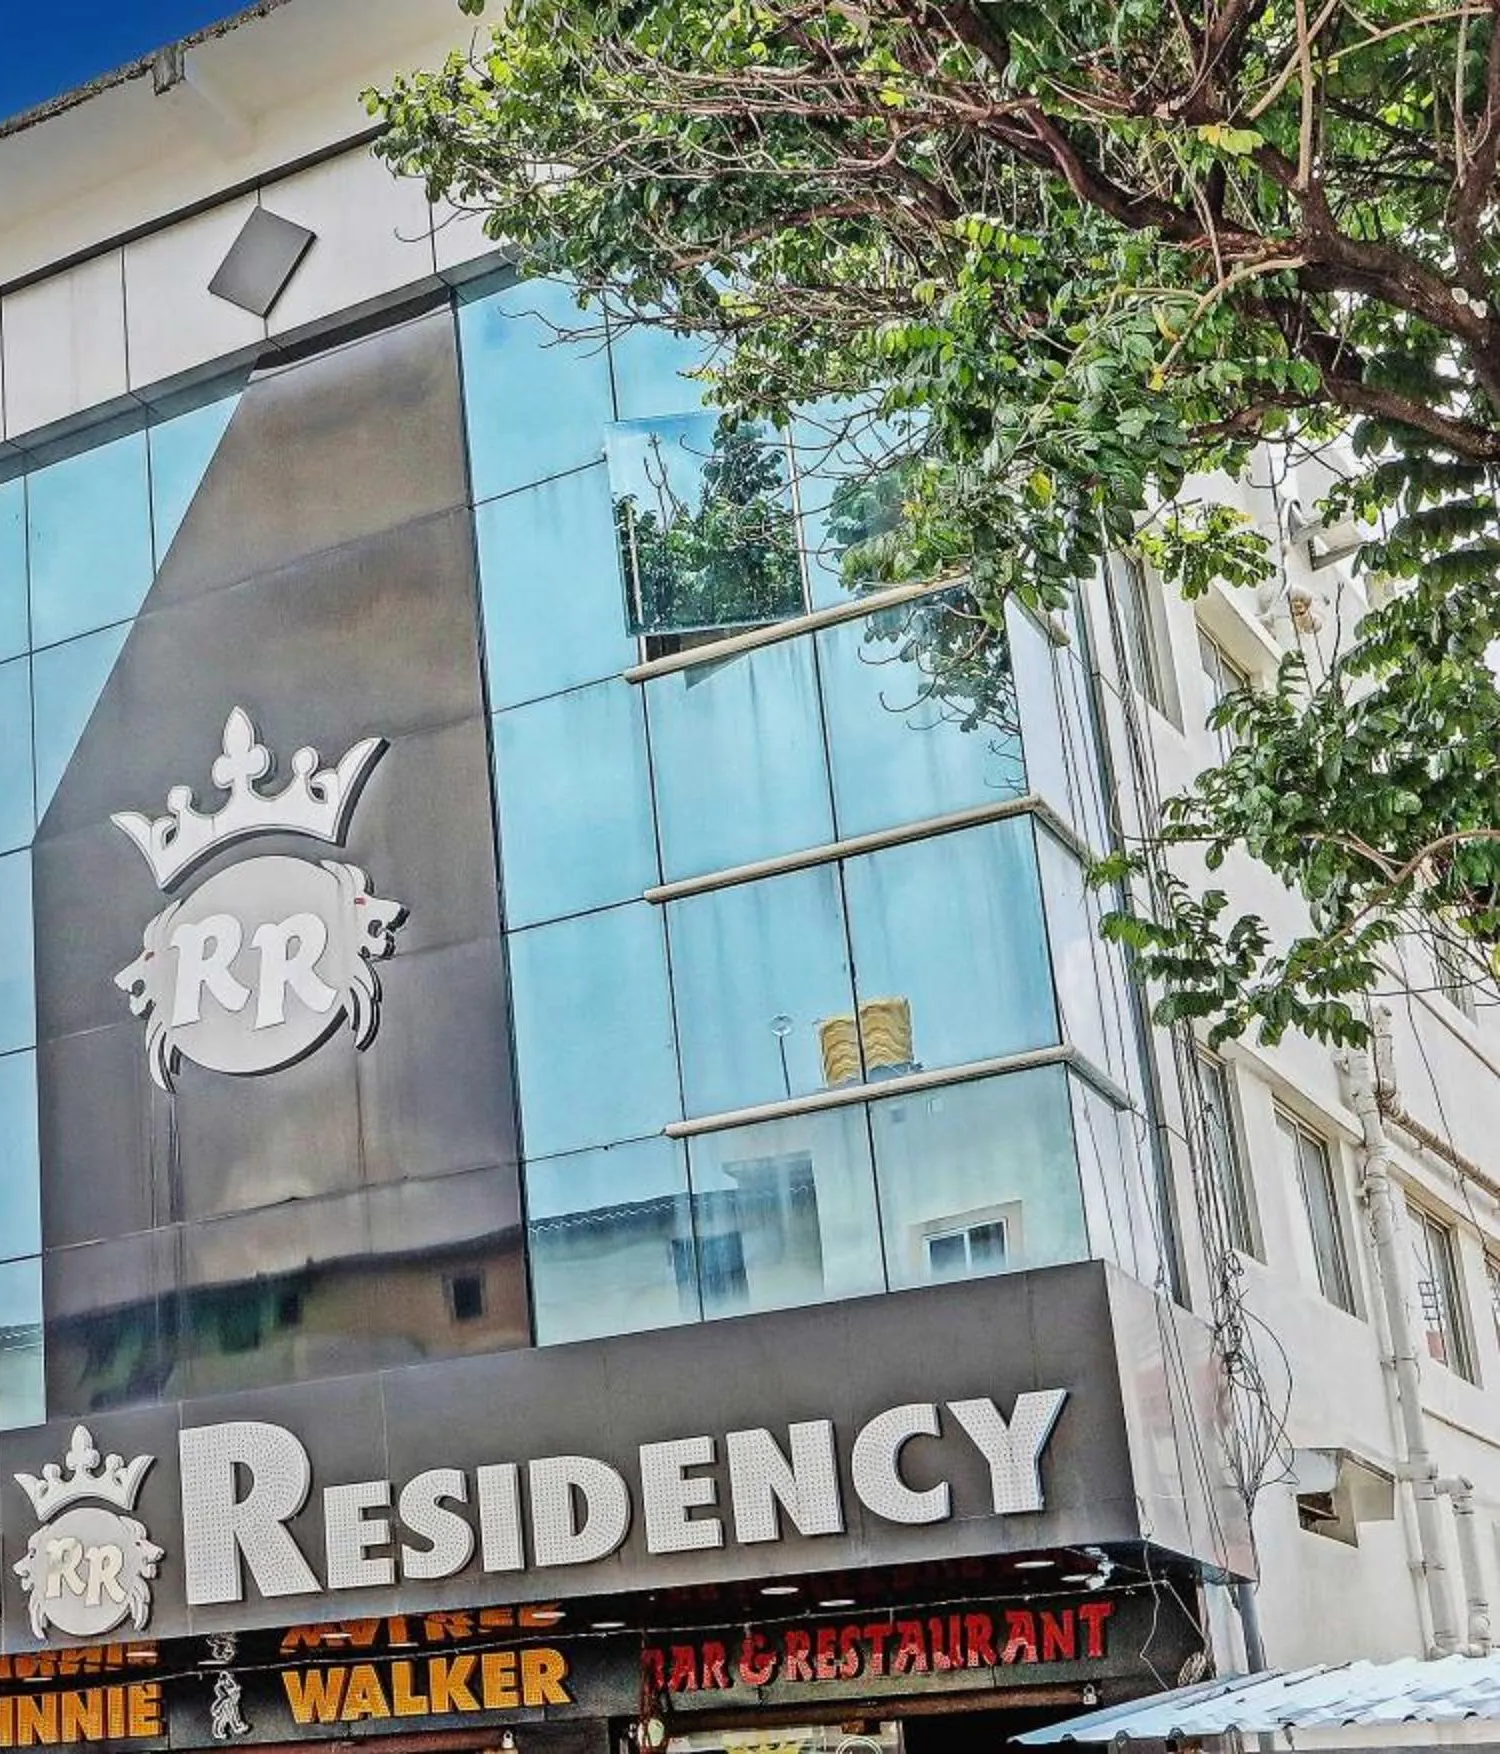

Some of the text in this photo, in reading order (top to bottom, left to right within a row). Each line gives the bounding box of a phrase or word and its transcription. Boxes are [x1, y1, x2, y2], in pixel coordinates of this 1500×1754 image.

[167, 912, 338, 1031] RR
[179, 1388, 1068, 1605] RESIDENCY
[281, 1647, 572, 1725] WALKER
[739, 1632, 778, 1686] &
[784, 1602, 1116, 1683] RESTAURANT
